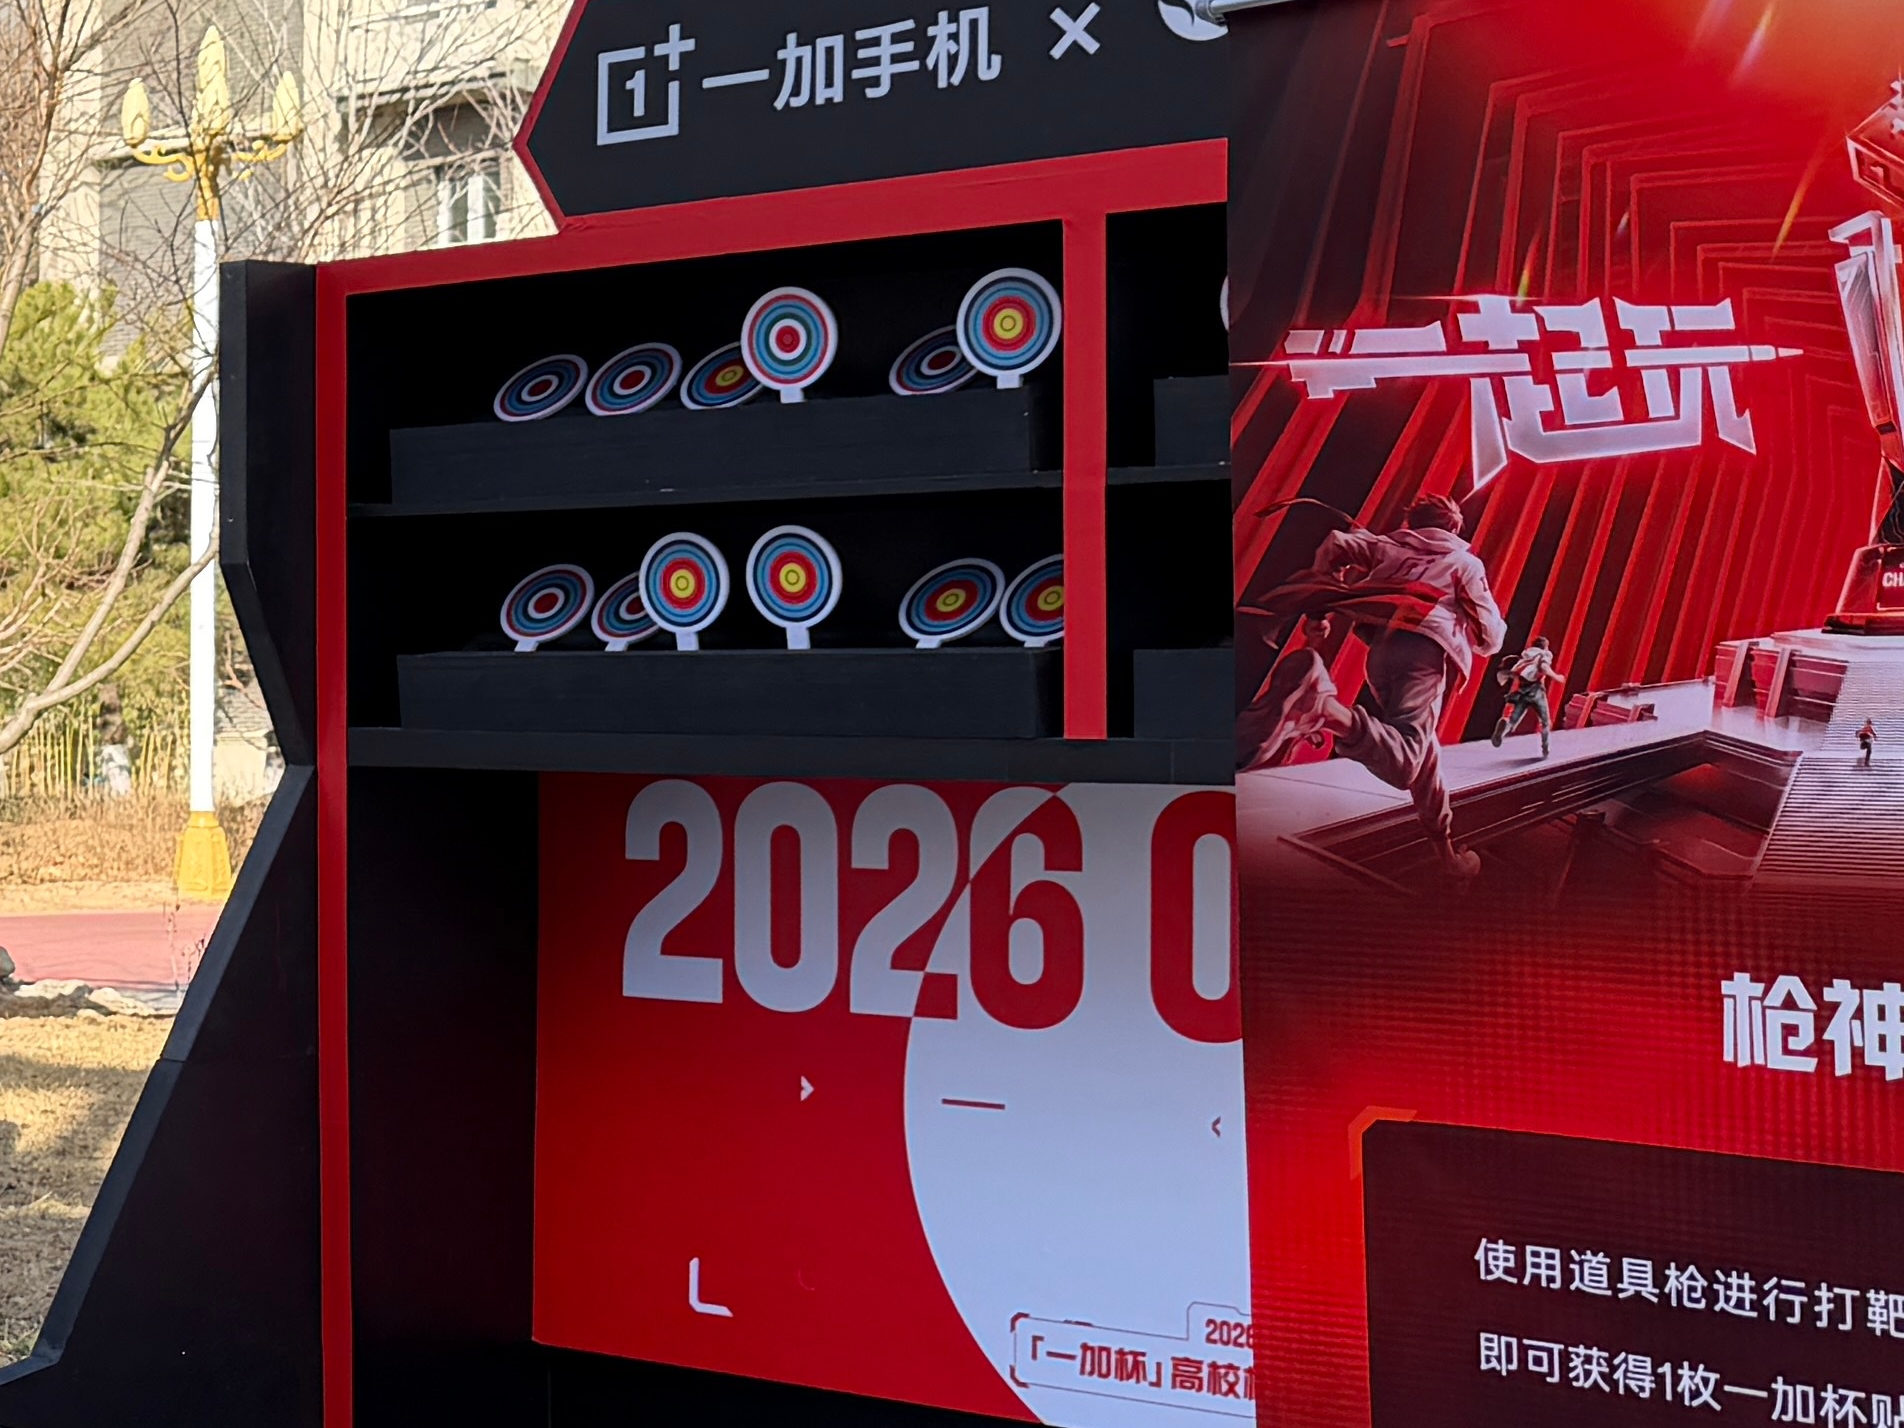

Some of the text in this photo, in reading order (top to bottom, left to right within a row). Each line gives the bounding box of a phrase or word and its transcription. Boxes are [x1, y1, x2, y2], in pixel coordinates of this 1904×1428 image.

[702, 6, 1002, 113] 一加手机
[1284, 294, 1805, 497] 一起玩
[622, 778, 1084, 1030] 2026
